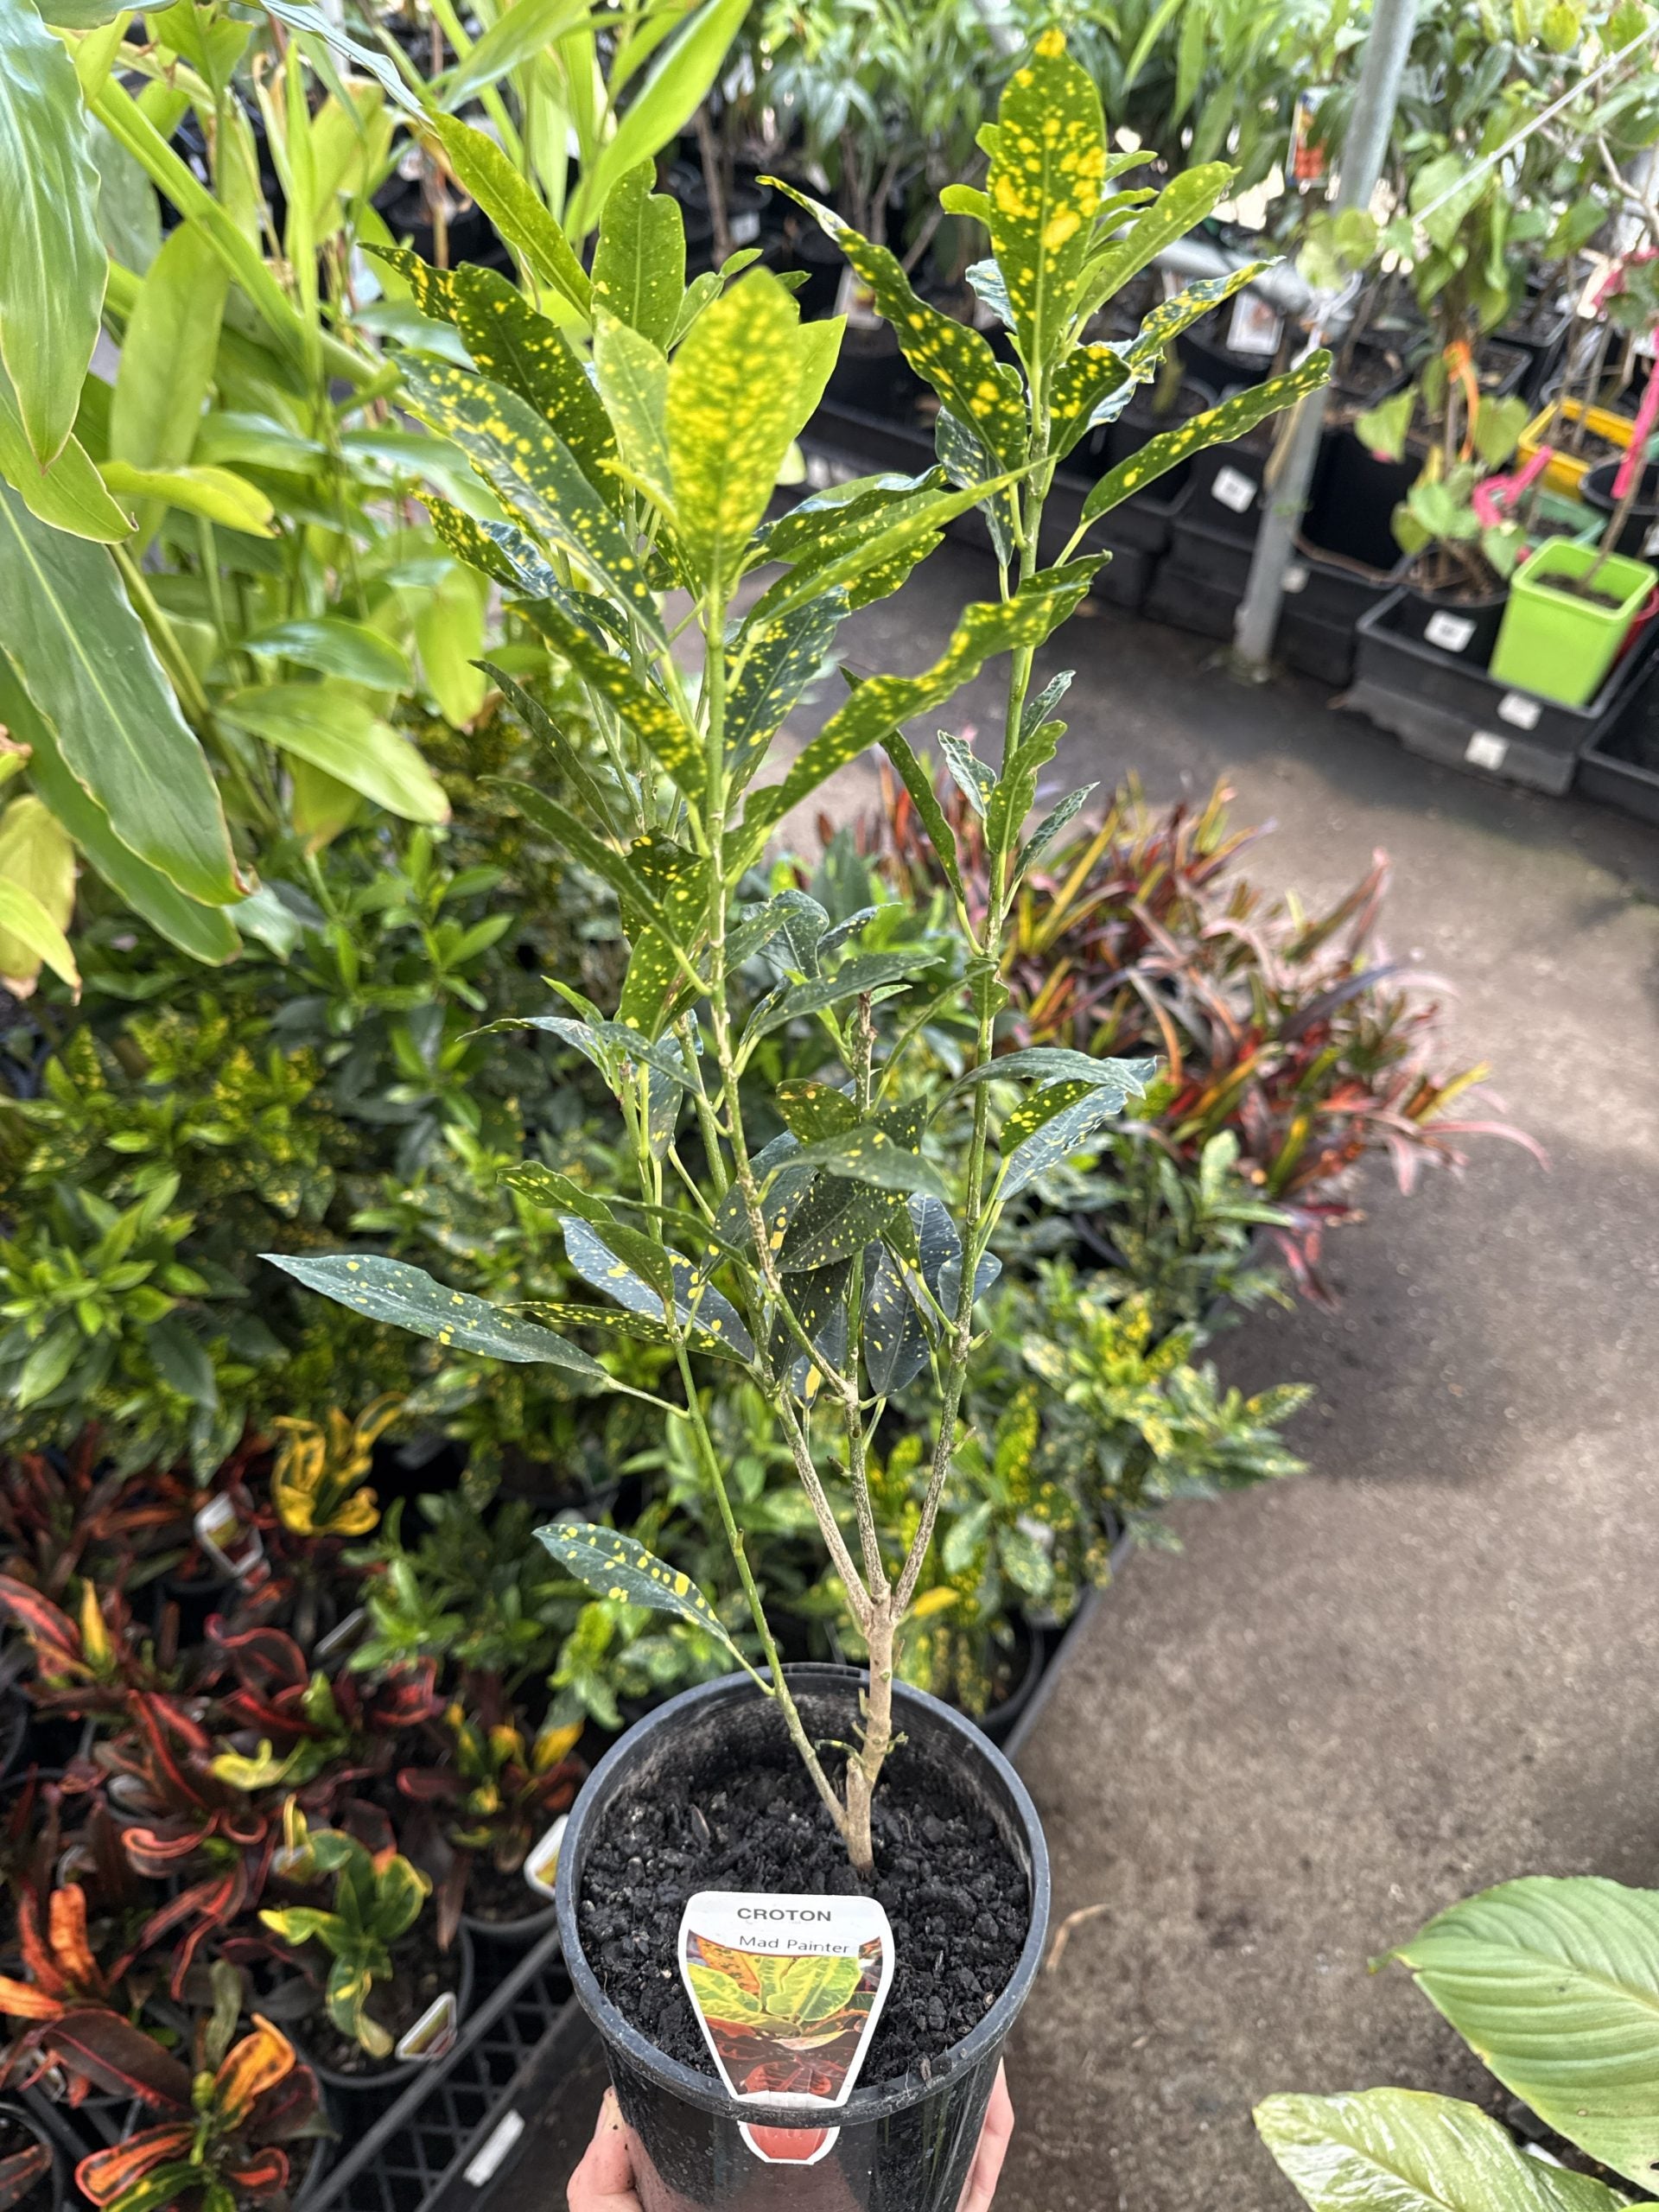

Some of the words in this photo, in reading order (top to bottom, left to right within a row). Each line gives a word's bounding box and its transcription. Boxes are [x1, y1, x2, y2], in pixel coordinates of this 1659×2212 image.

[737, 1908, 831, 1922] CROTON
[740, 1936, 779, 1948] Mad
[787, 1939, 849, 1954] Painter
